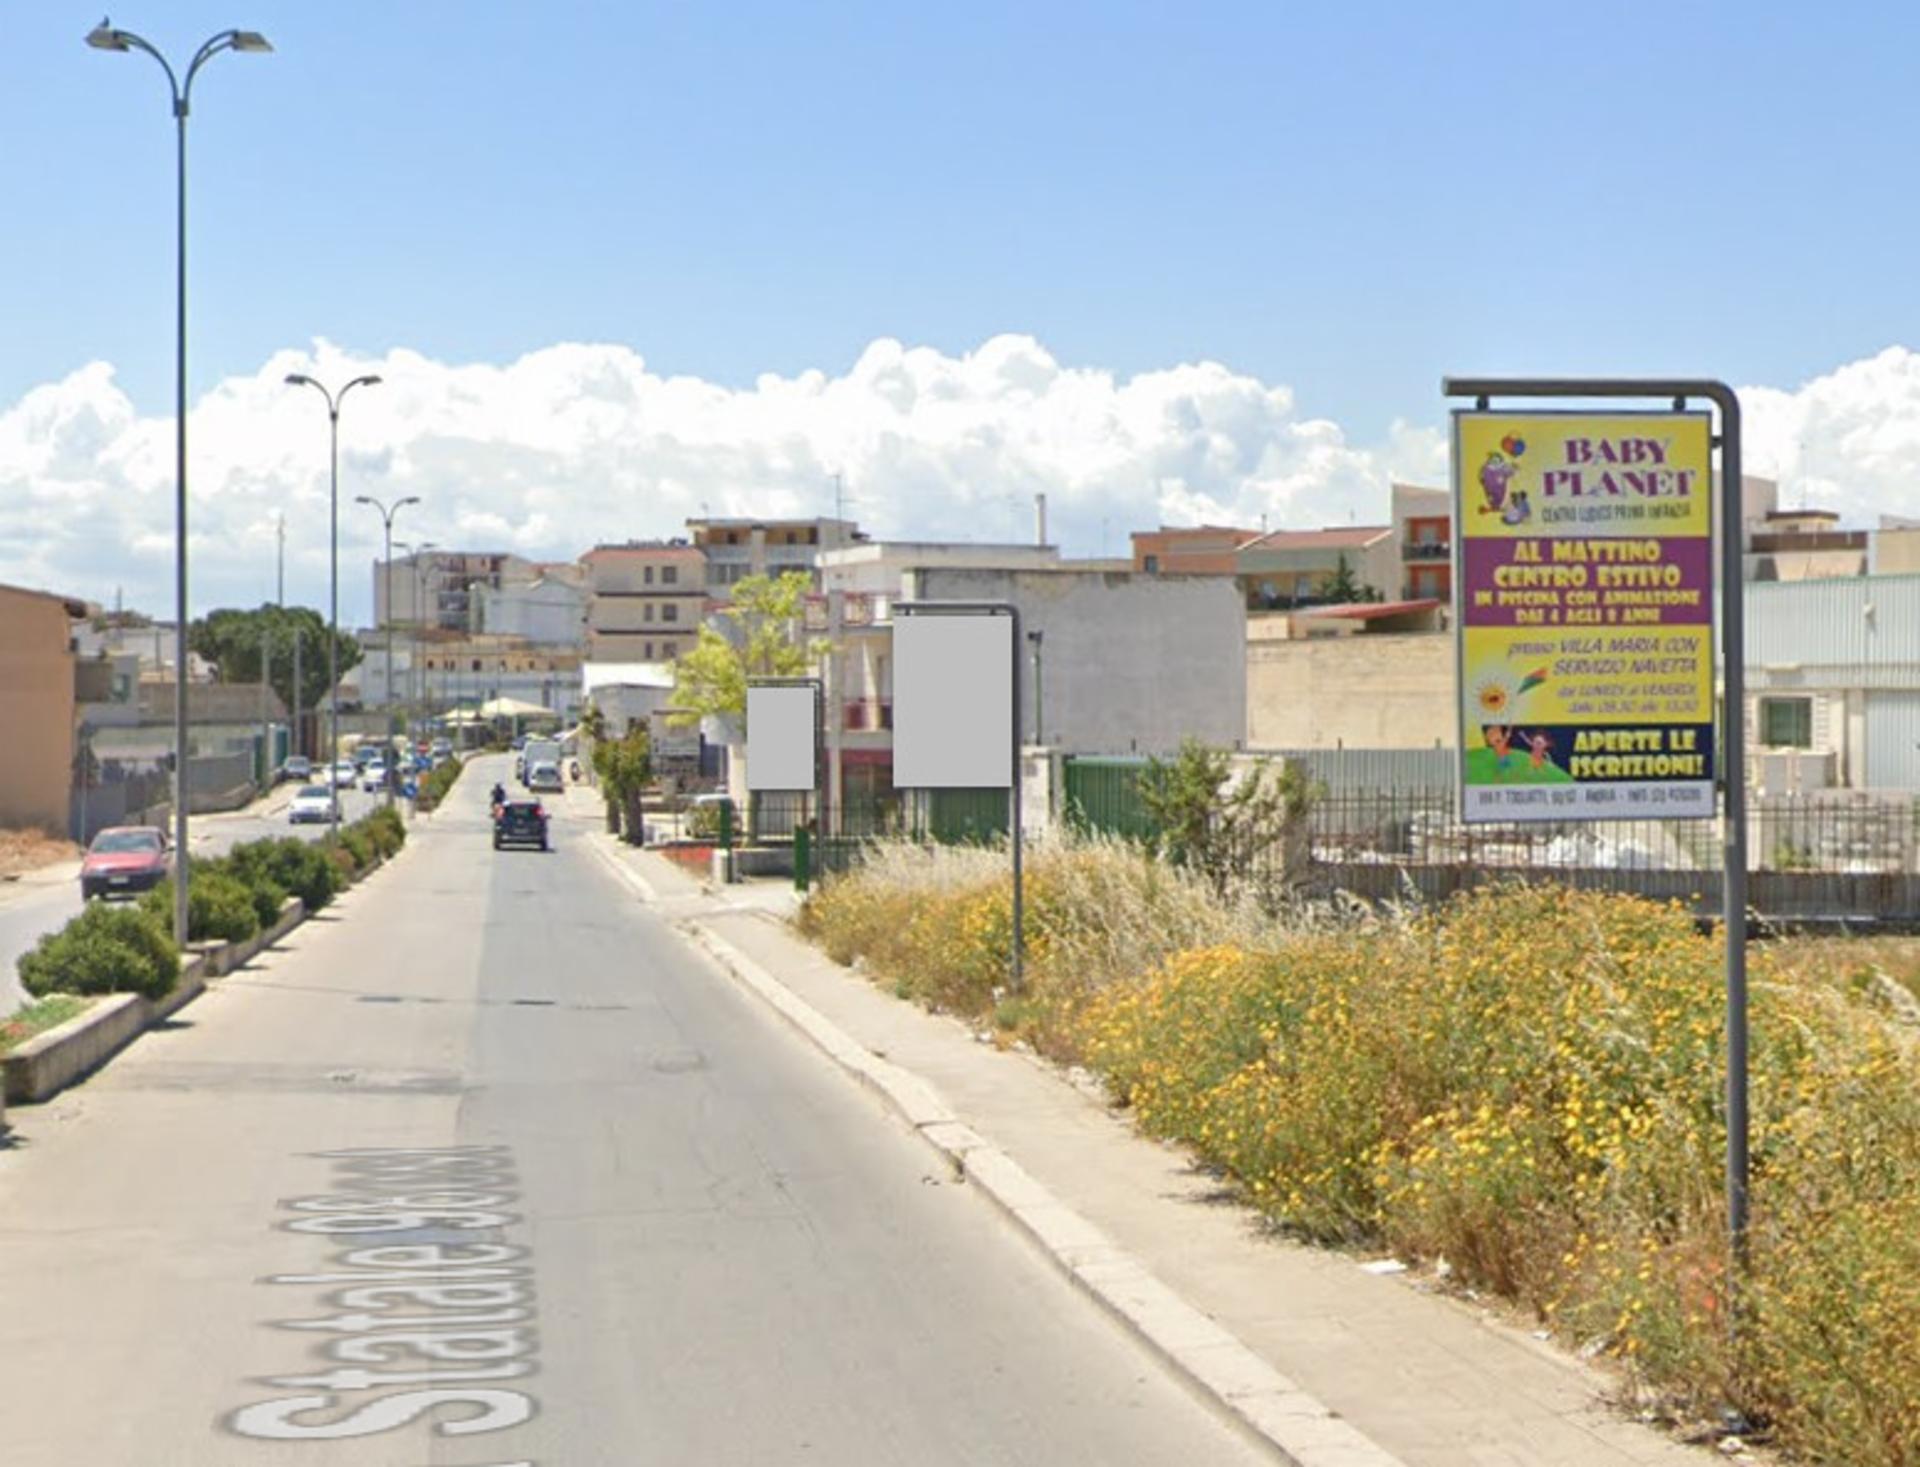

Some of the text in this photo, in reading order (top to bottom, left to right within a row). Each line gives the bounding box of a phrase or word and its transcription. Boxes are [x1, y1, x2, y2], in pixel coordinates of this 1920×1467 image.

[1564, 438, 1670, 465] BABY
[1542, 470, 1697, 497] PLANET
[1513, 539, 1661, 562] AL MATTINO
[1493, 563, 1682, 588] CENTRO ESTIVO
[1474, 589, 1701, 607] IN PISCINA CON ANIMAZIONE
[1565, 608, 1602, 623] AGLI
[1560, 637, 1604, 654] VILLA
[1608, 637, 1661, 654] MARIA
[1663, 636, 1700, 653] CON
[1552, 657, 1699, 676] SERVIZIO NAVETTA
[1573, 729, 1698, 752] APERTE LE
[1569, 755, 1705, 778] ISCRIZIONI!
